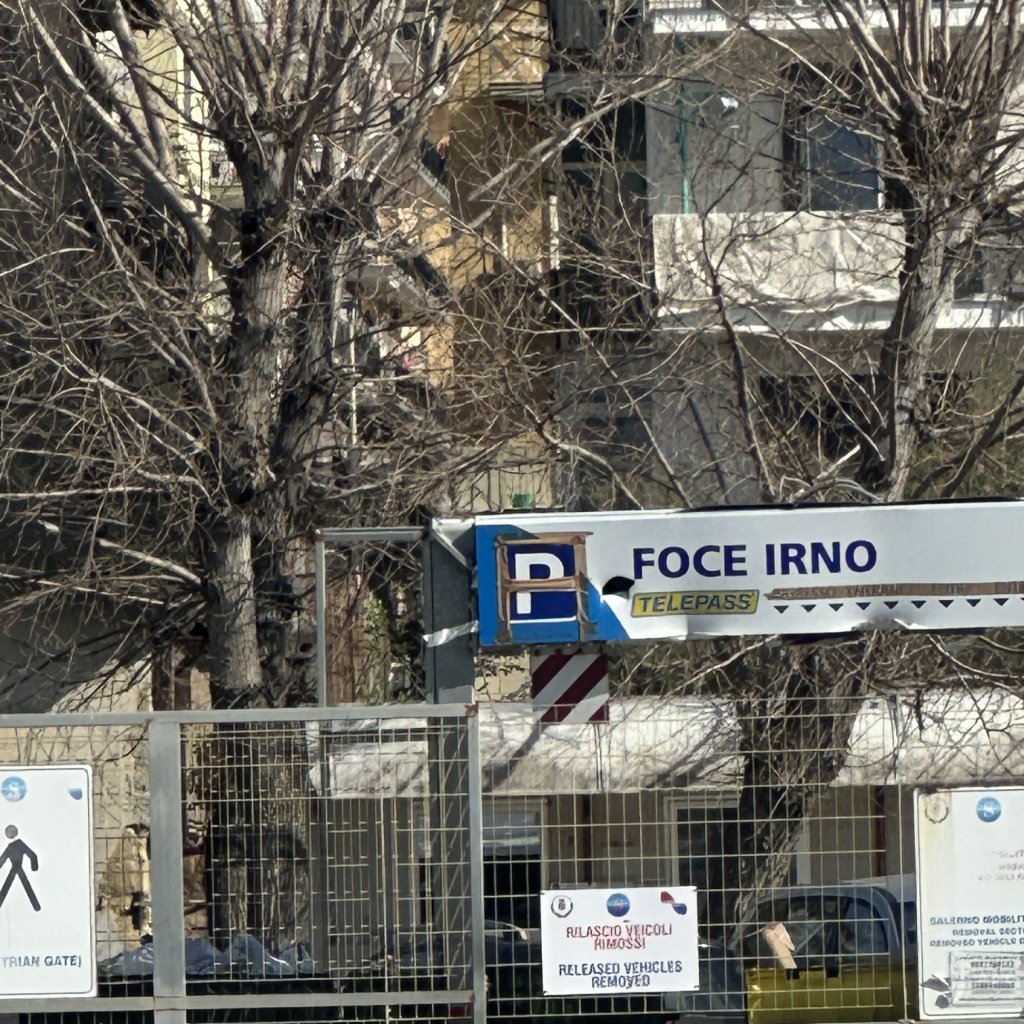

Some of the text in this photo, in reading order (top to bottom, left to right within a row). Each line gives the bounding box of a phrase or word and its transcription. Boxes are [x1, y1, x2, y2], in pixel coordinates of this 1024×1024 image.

[632, 539, 878, 580] FOCE IRNO
[514, 552, 565, 614] P
[638, 590, 754, 614] TELEPASS
[566, 923, 673, 939] RILASCIO VEICOLI
[594, 936, 646, 951] RIMOSSI
[558, 960, 683, 977] RELEASED VEHICLES
[591, 974, 651, 989] REMOVED
